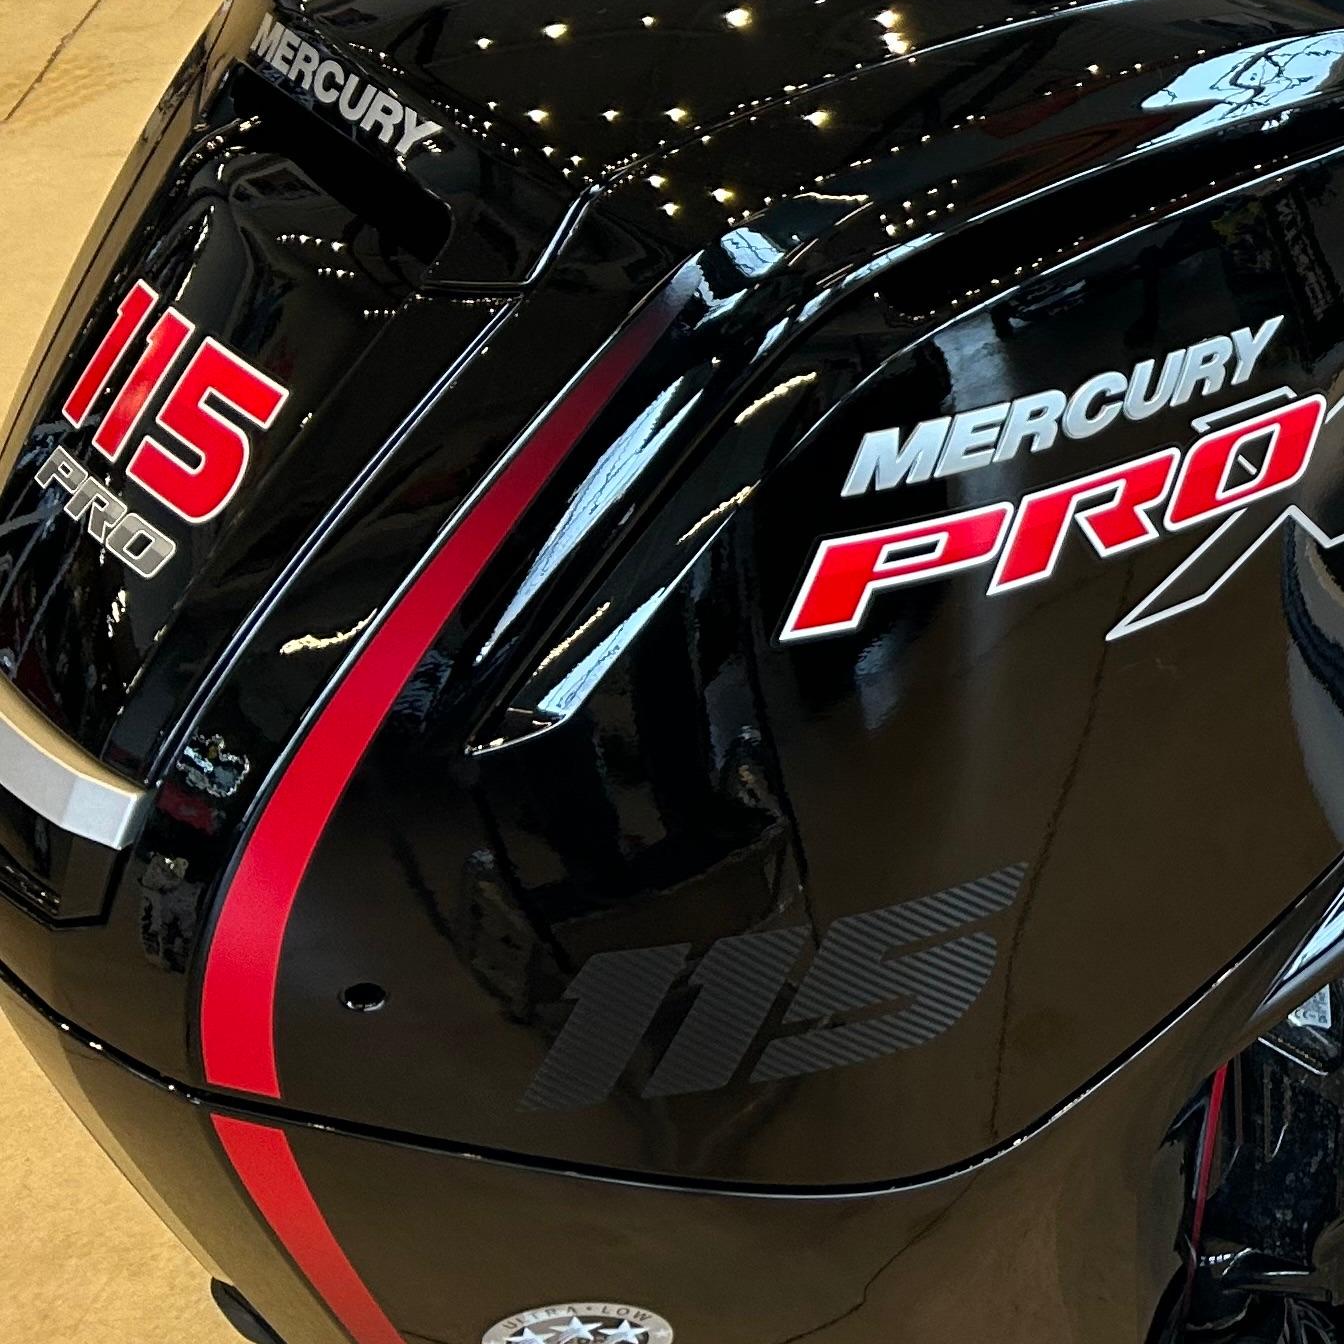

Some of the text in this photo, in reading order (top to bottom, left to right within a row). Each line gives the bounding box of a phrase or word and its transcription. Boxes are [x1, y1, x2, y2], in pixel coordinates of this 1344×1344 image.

[250, 13, 443, 156] MERCURY
[62, 279, 290, 525] 115
[841, 315, 1286, 498] MERCURY
[34, 446, 177, 579] PRO
[779, 391, 1328, 644] PRO
[515, 861, 1029, 1113] 115
[503, 1305, 652, 1331] ULTRA LOW
